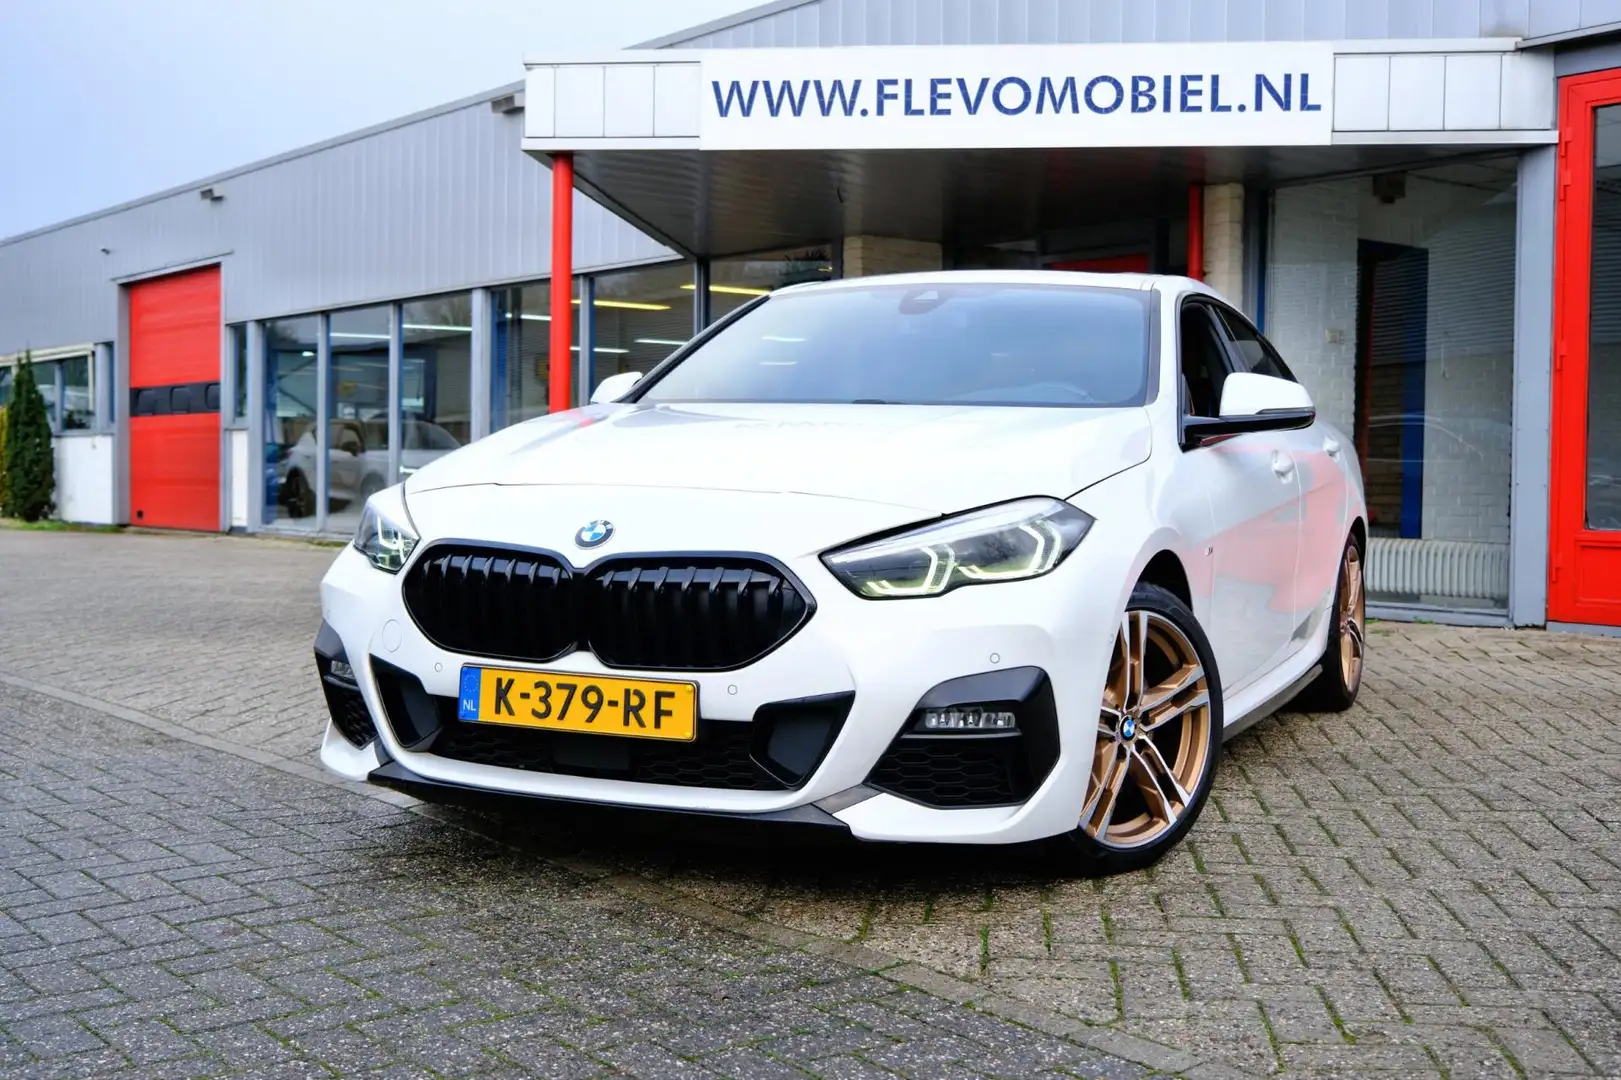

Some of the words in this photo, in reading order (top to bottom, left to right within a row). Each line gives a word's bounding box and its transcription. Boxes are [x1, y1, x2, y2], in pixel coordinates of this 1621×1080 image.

[711, 73, 1322, 117] WWW.FLEVOMOBIEL.NL
[463, 699, 477, 711] NL
[494, 677, 676, 730] K-379-RF
